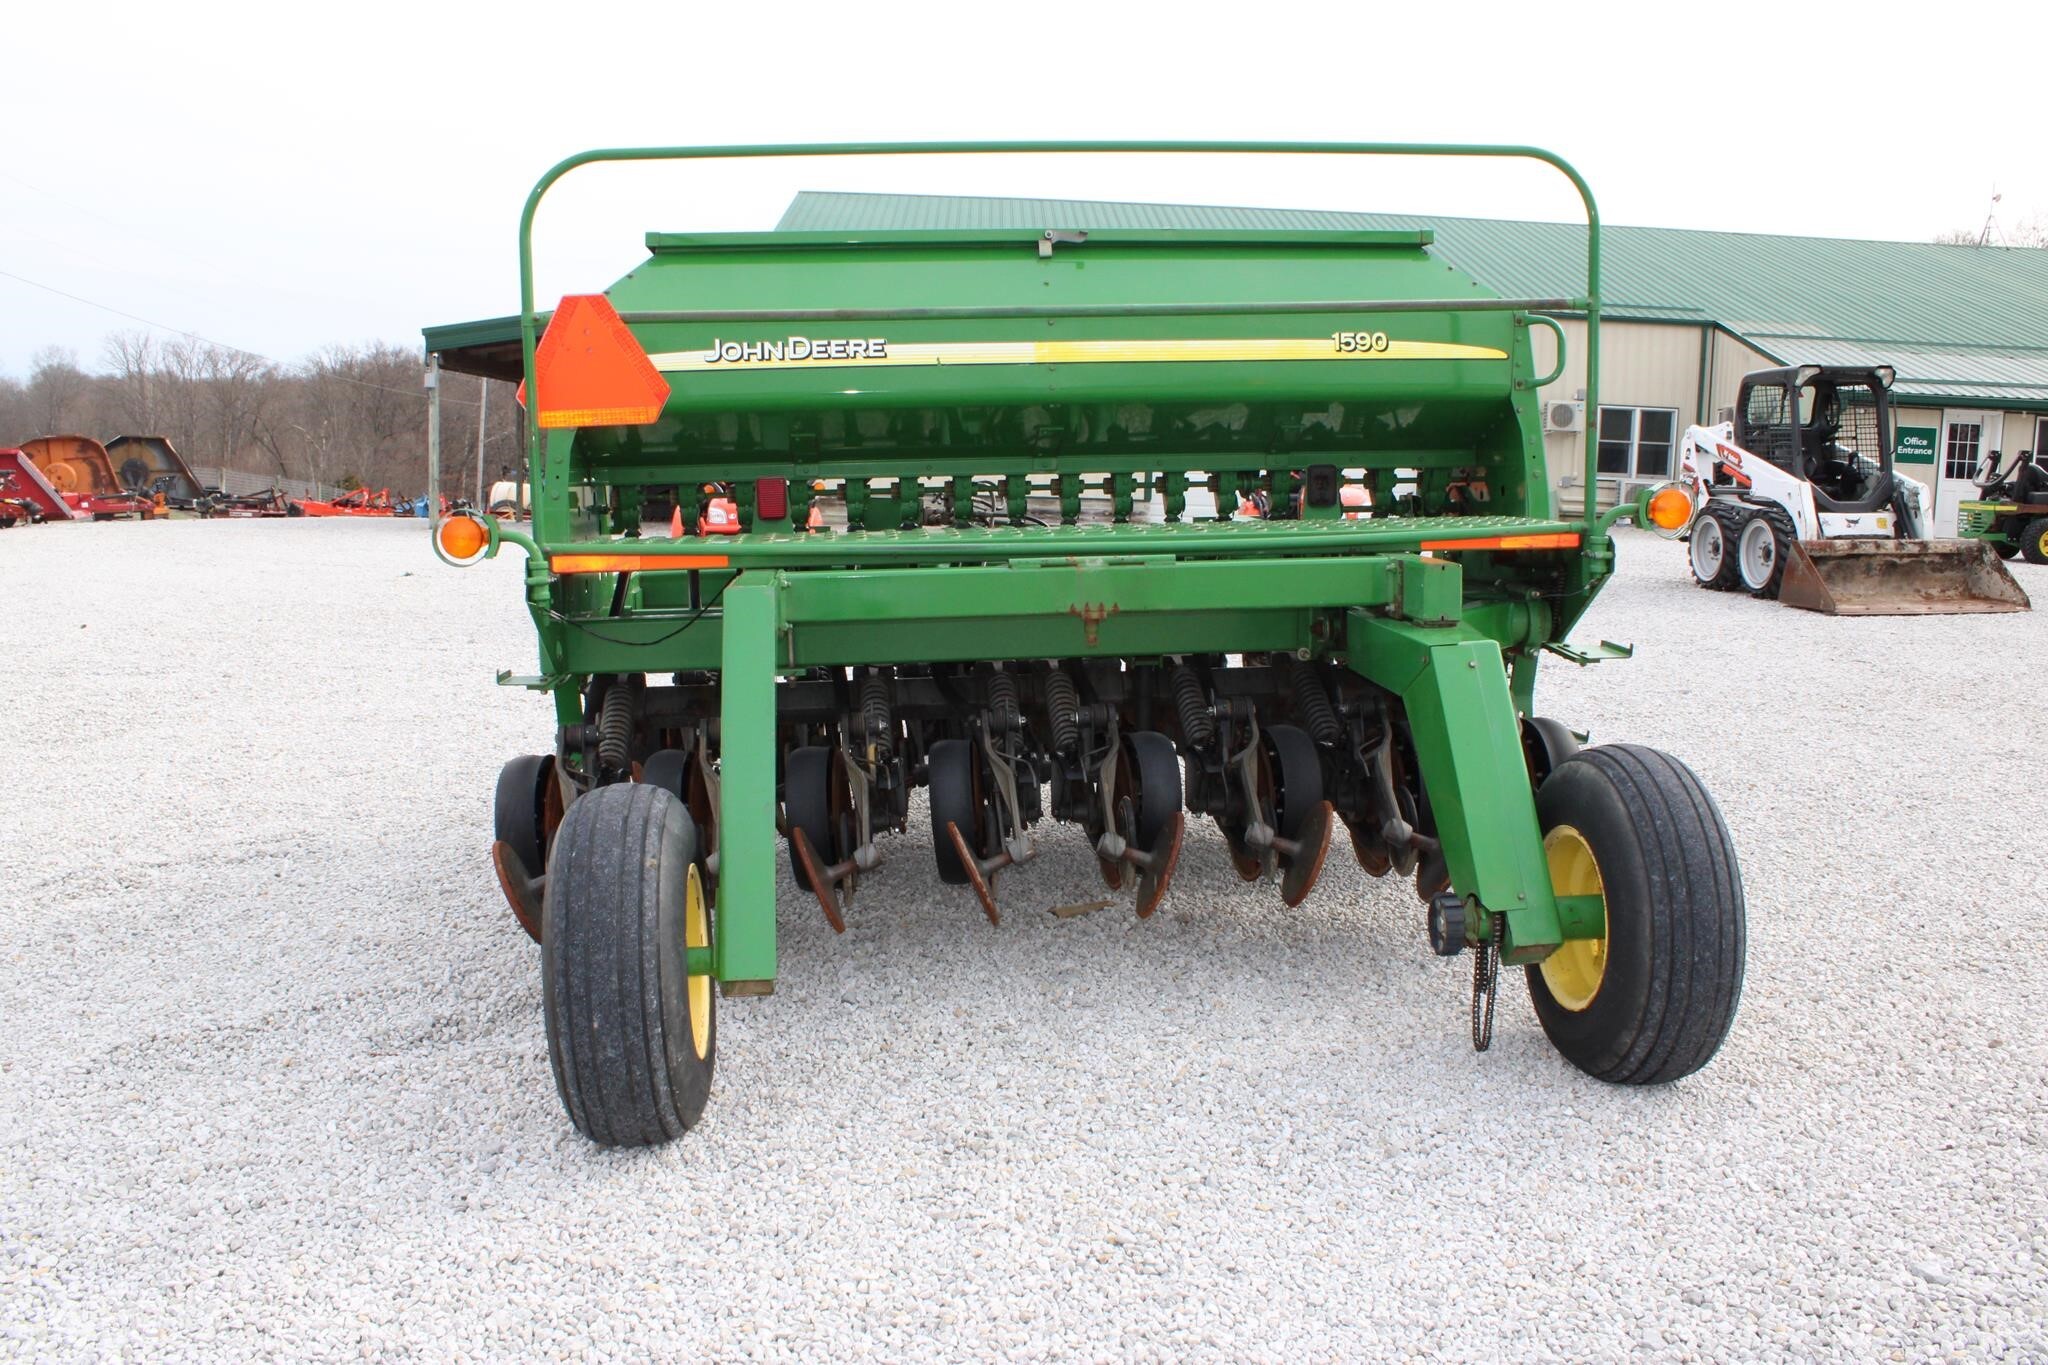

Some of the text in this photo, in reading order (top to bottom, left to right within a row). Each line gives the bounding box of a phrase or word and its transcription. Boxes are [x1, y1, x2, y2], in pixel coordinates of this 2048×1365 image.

[1331, 331, 1389, 352] 1590
[704, 336, 888, 363] JOHN DEERE
[1903, 436, 1928, 446] Office
[1897, 445, 1933, 455] Entrance
